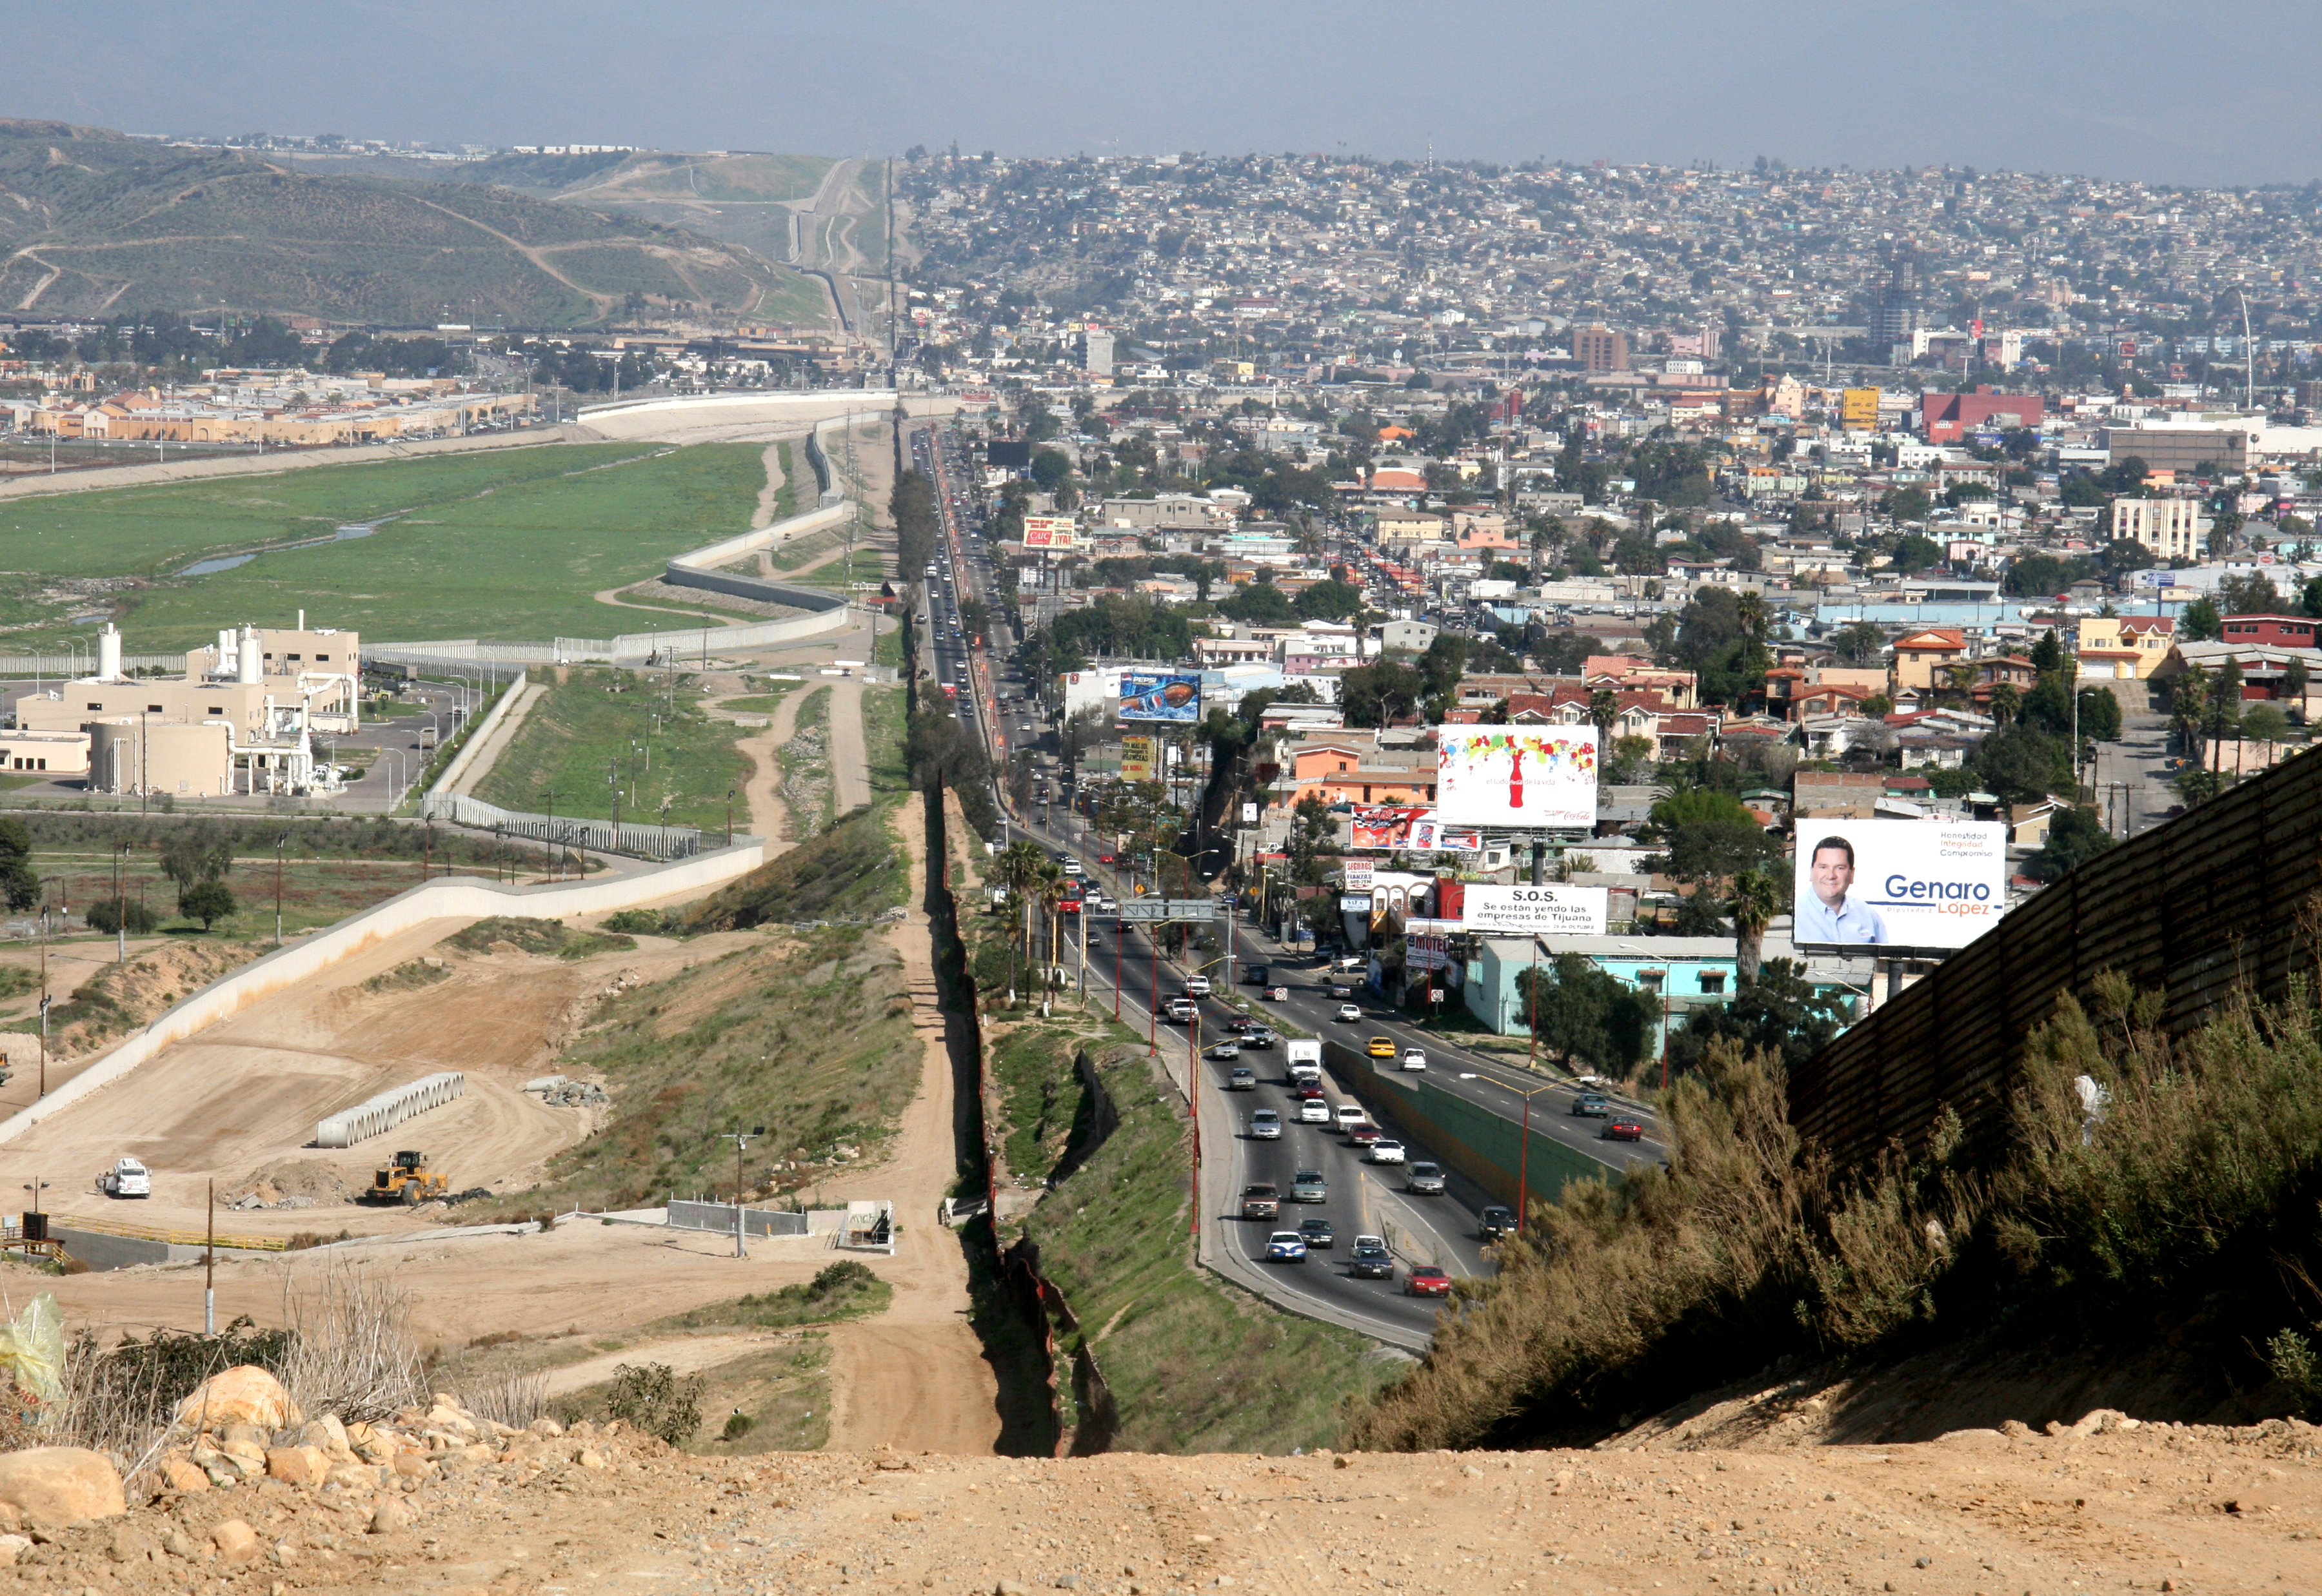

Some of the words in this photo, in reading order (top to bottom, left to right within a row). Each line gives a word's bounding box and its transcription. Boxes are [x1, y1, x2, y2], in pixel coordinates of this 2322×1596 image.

[1030, 531, 1050, 540] CAIC
[1941, 840, 1983, 849] Integridad
[1940, 849, 1993, 858] Compromiso
[1885, 874, 1990, 901] Genaro
[1513, 891, 1558, 901] S.O.S.
[1534, 905, 1567, 913] yendo
[1938, 901, 1990, 917] López
[1477, 912, 1531, 921] empresas
[1551, 914, 1591, 923] Tijuana
